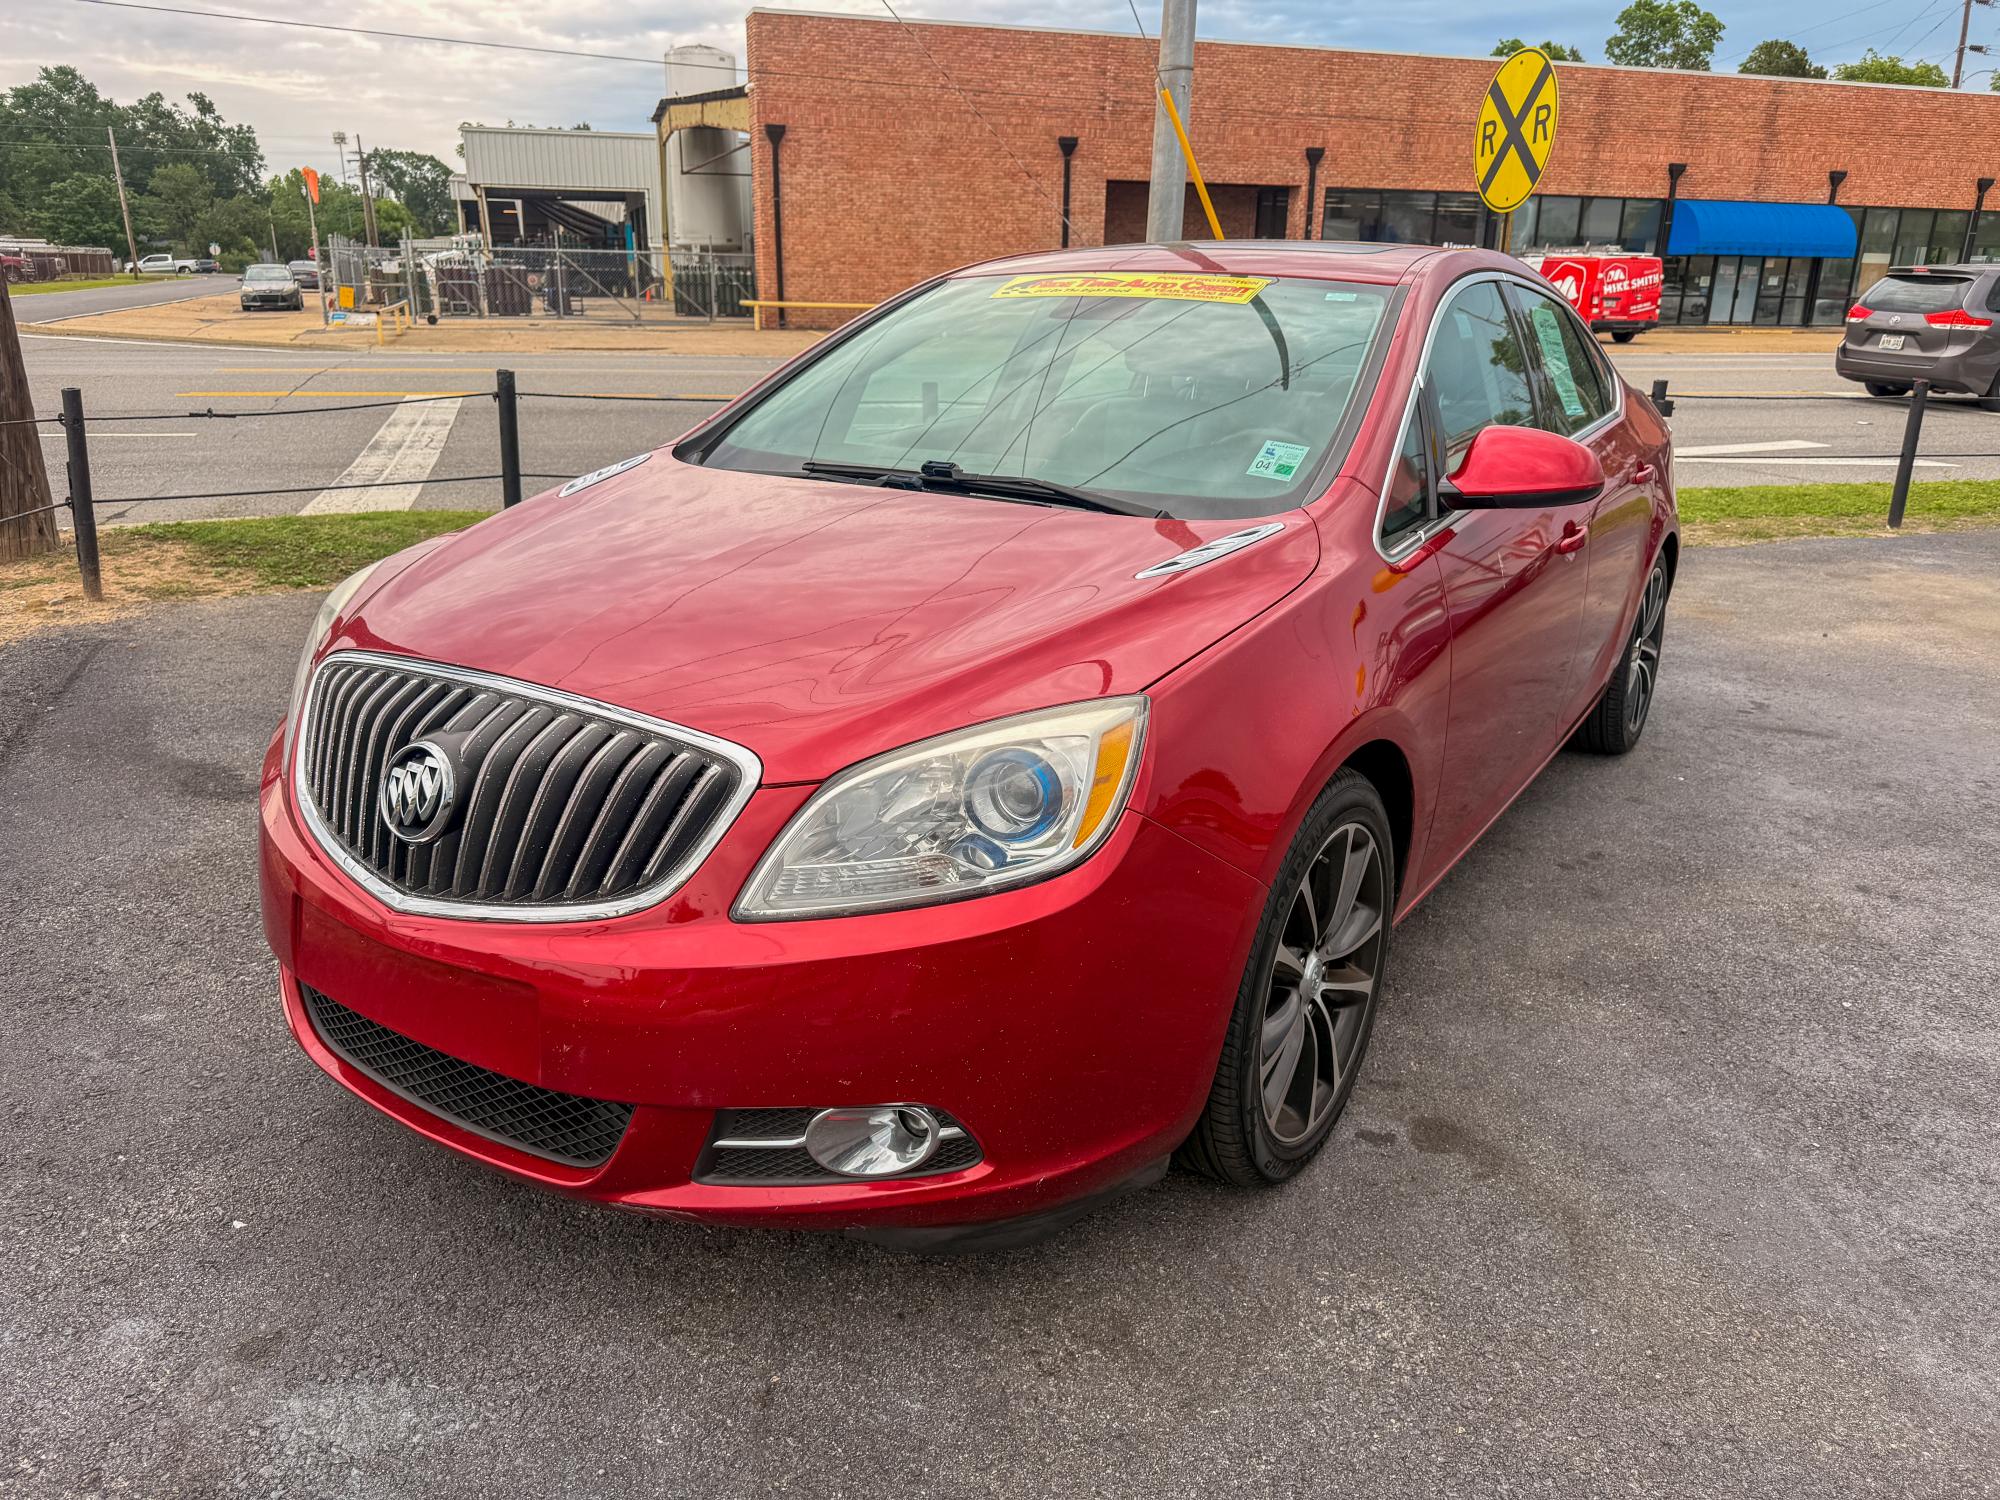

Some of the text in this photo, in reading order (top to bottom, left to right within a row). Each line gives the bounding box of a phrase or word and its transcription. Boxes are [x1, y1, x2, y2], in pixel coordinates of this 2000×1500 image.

[1481, 120, 1497, 157] R
[1533, 104, 1551, 144] R
[1603, 280, 1630, 295] MIKE
[1631, 273, 1659, 290] SMITH
[1255, 460, 1271, 471] 04
